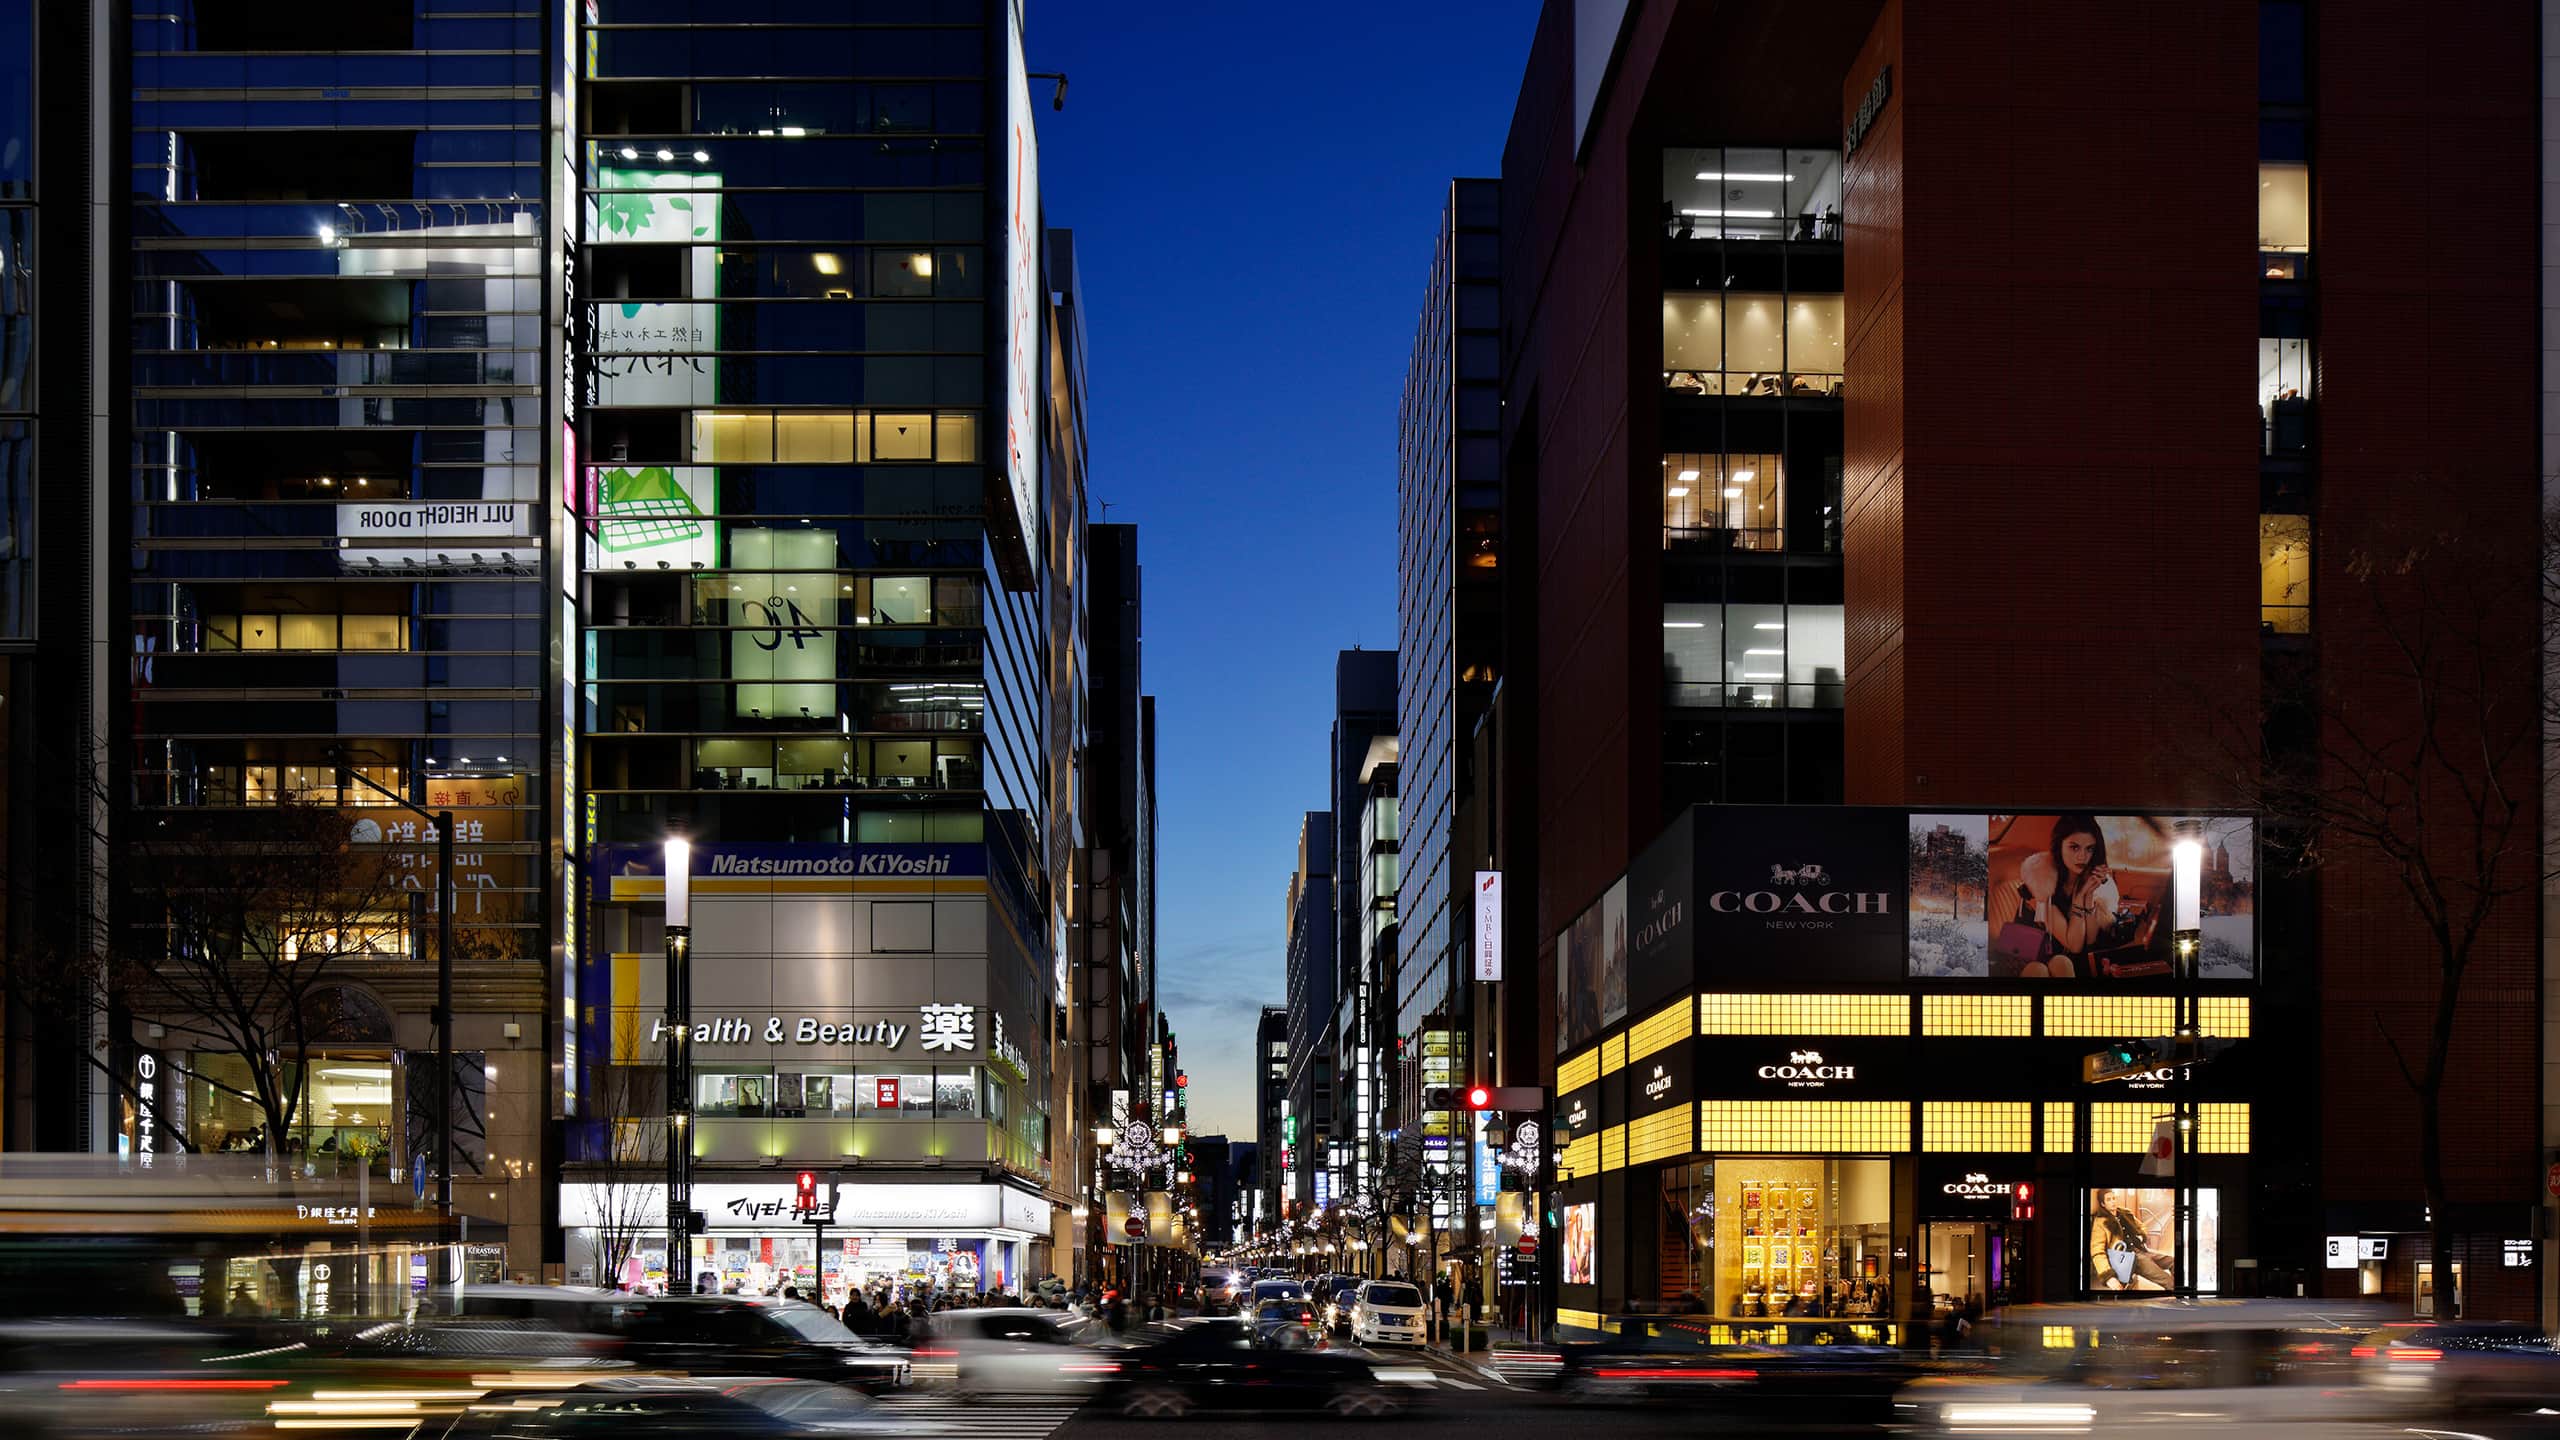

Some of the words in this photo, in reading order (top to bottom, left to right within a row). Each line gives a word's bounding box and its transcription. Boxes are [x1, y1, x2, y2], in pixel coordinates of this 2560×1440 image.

[711, 854, 853, 875] Matsumoto
[858, 854, 951, 875] KiYoshi
[1709, 890, 1891, 915] COACH
[1635, 901, 1682, 953] COACH
[1766, 920, 1796, 930] NEW
[1799, 920, 1834, 930] YORK
[650, 1016, 753, 1043] Halth
[763, 1016, 785, 1043] &
[794, 1016, 907, 1049] Beauty
[919, 1003, 976, 1053] 薬
[1758, 1066, 1855, 1080] COACH
[2120, 1067, 2190, 1081] ACH
[1645, 1075, 1672, 1096] COACH
[1568, 1108, 1587, 1125] COACH
[1943, 1183, 2011, 1194] COACH
